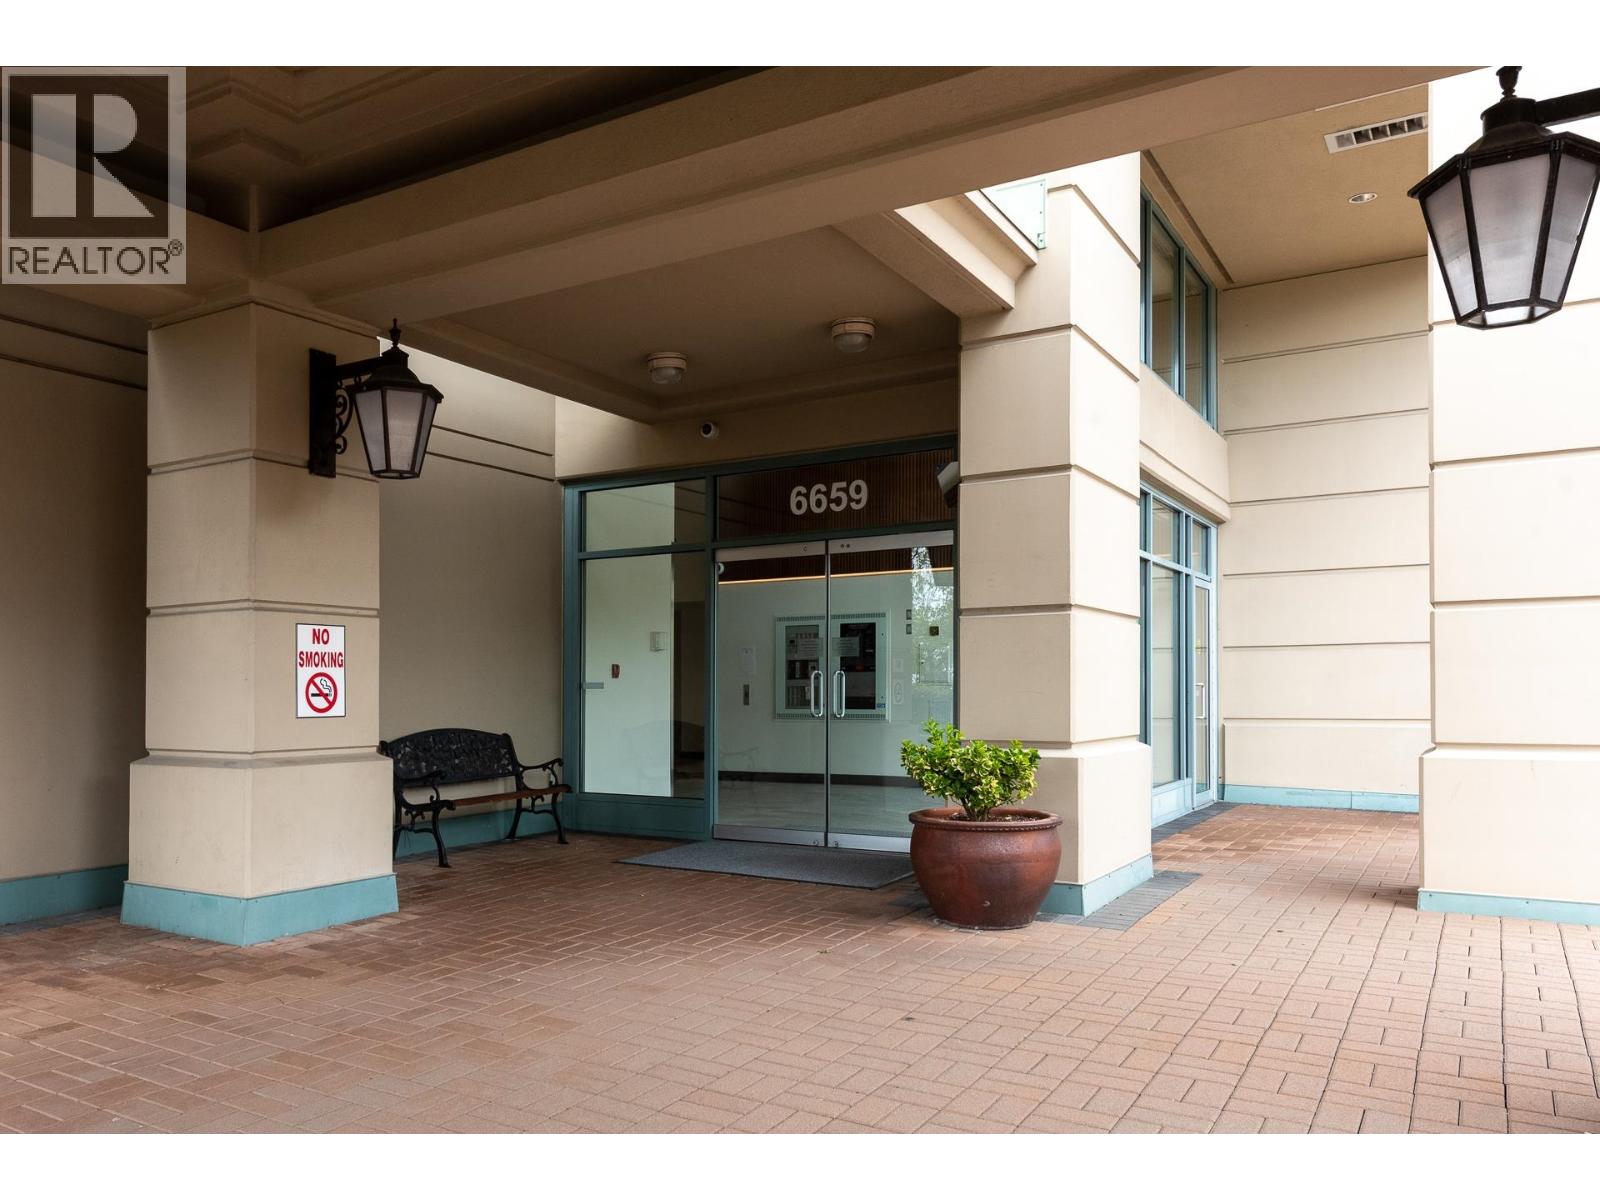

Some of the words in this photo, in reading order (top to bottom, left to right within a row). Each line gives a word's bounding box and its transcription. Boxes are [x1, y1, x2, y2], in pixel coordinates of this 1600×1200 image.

[789, 479, 868, 516] 6659
[311, 628, 330, 645] NO
[298, 650, 344, 668] SMOKING
